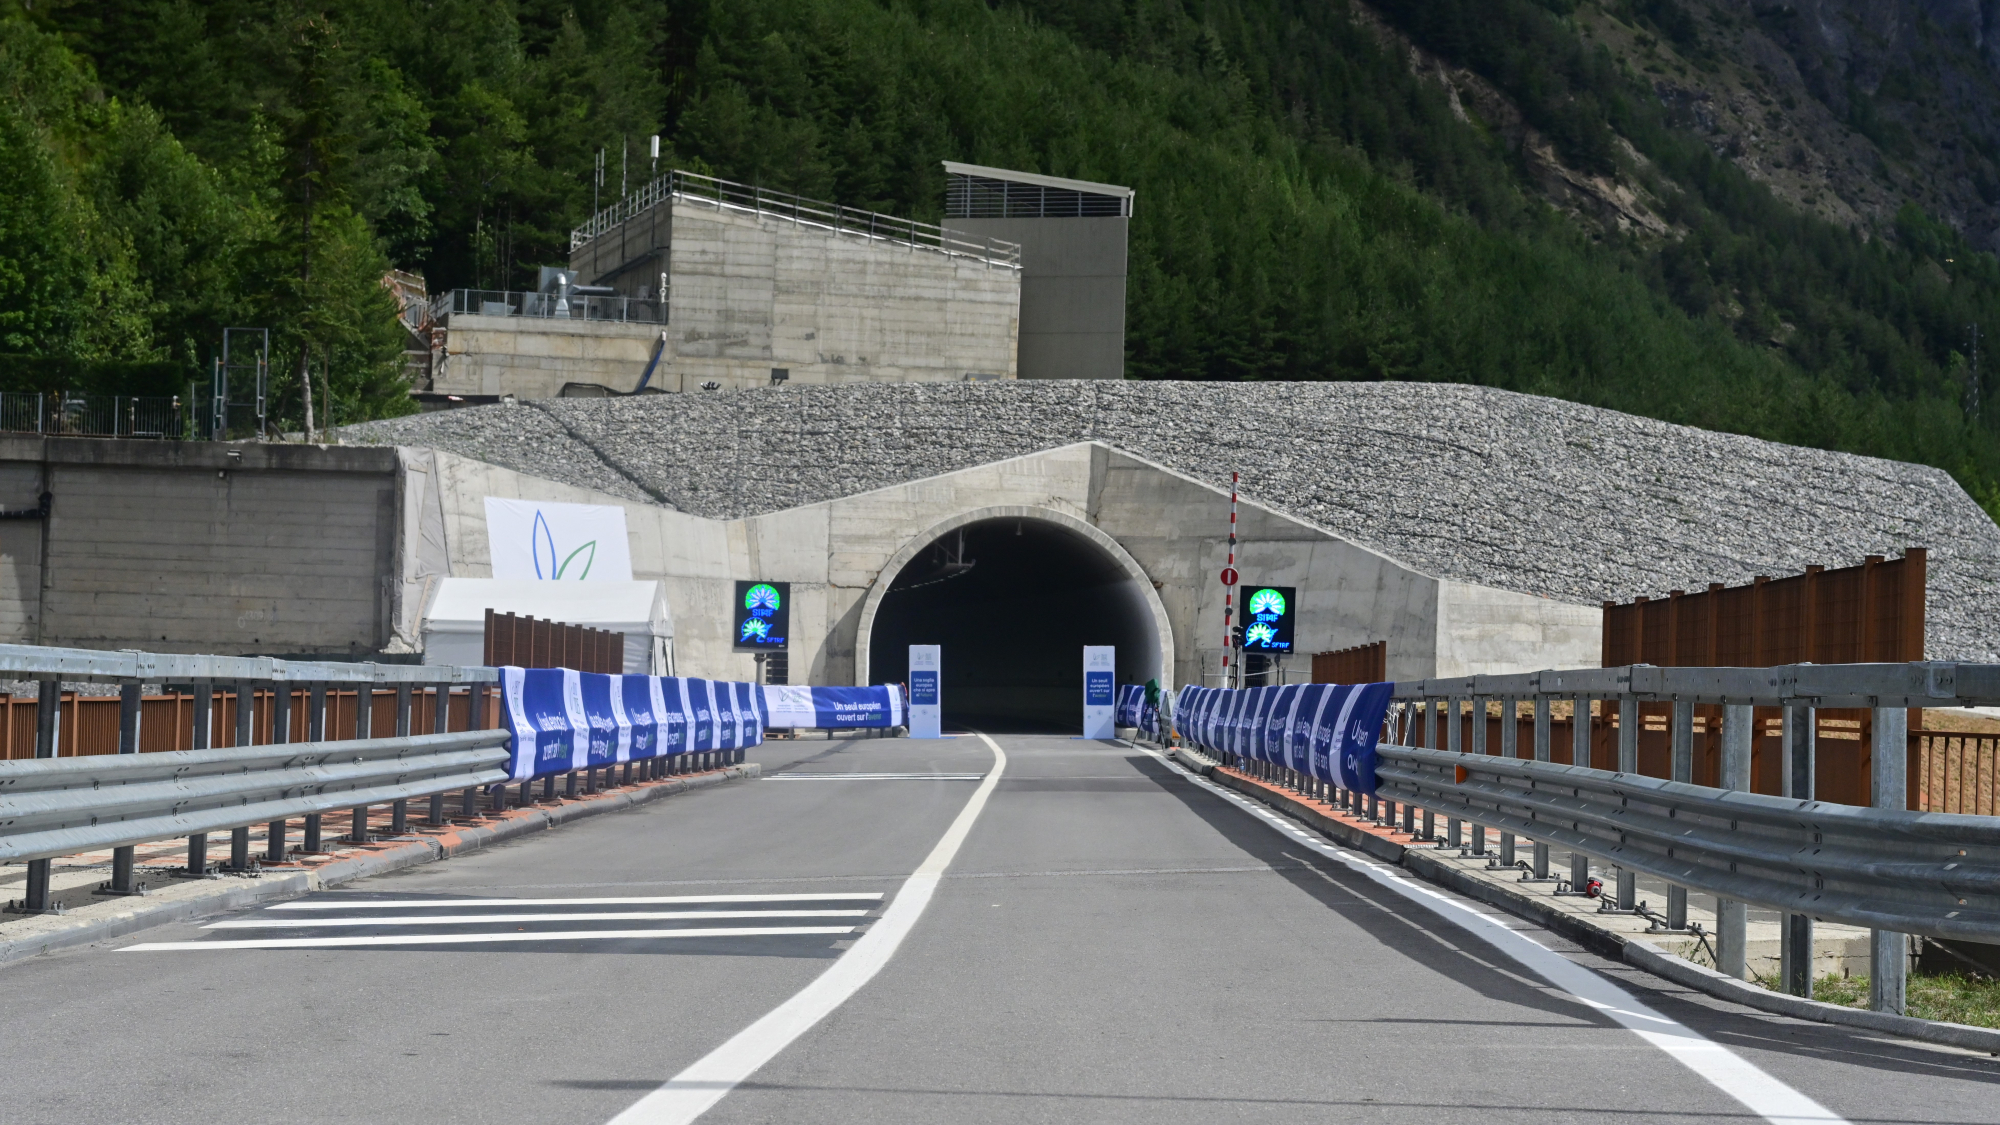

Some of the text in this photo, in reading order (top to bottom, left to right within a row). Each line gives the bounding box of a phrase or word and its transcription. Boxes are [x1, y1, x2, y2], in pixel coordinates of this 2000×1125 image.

[833, 701, 881, 712] Un seuil européen
[836, 713, 856, 721] ouvert
